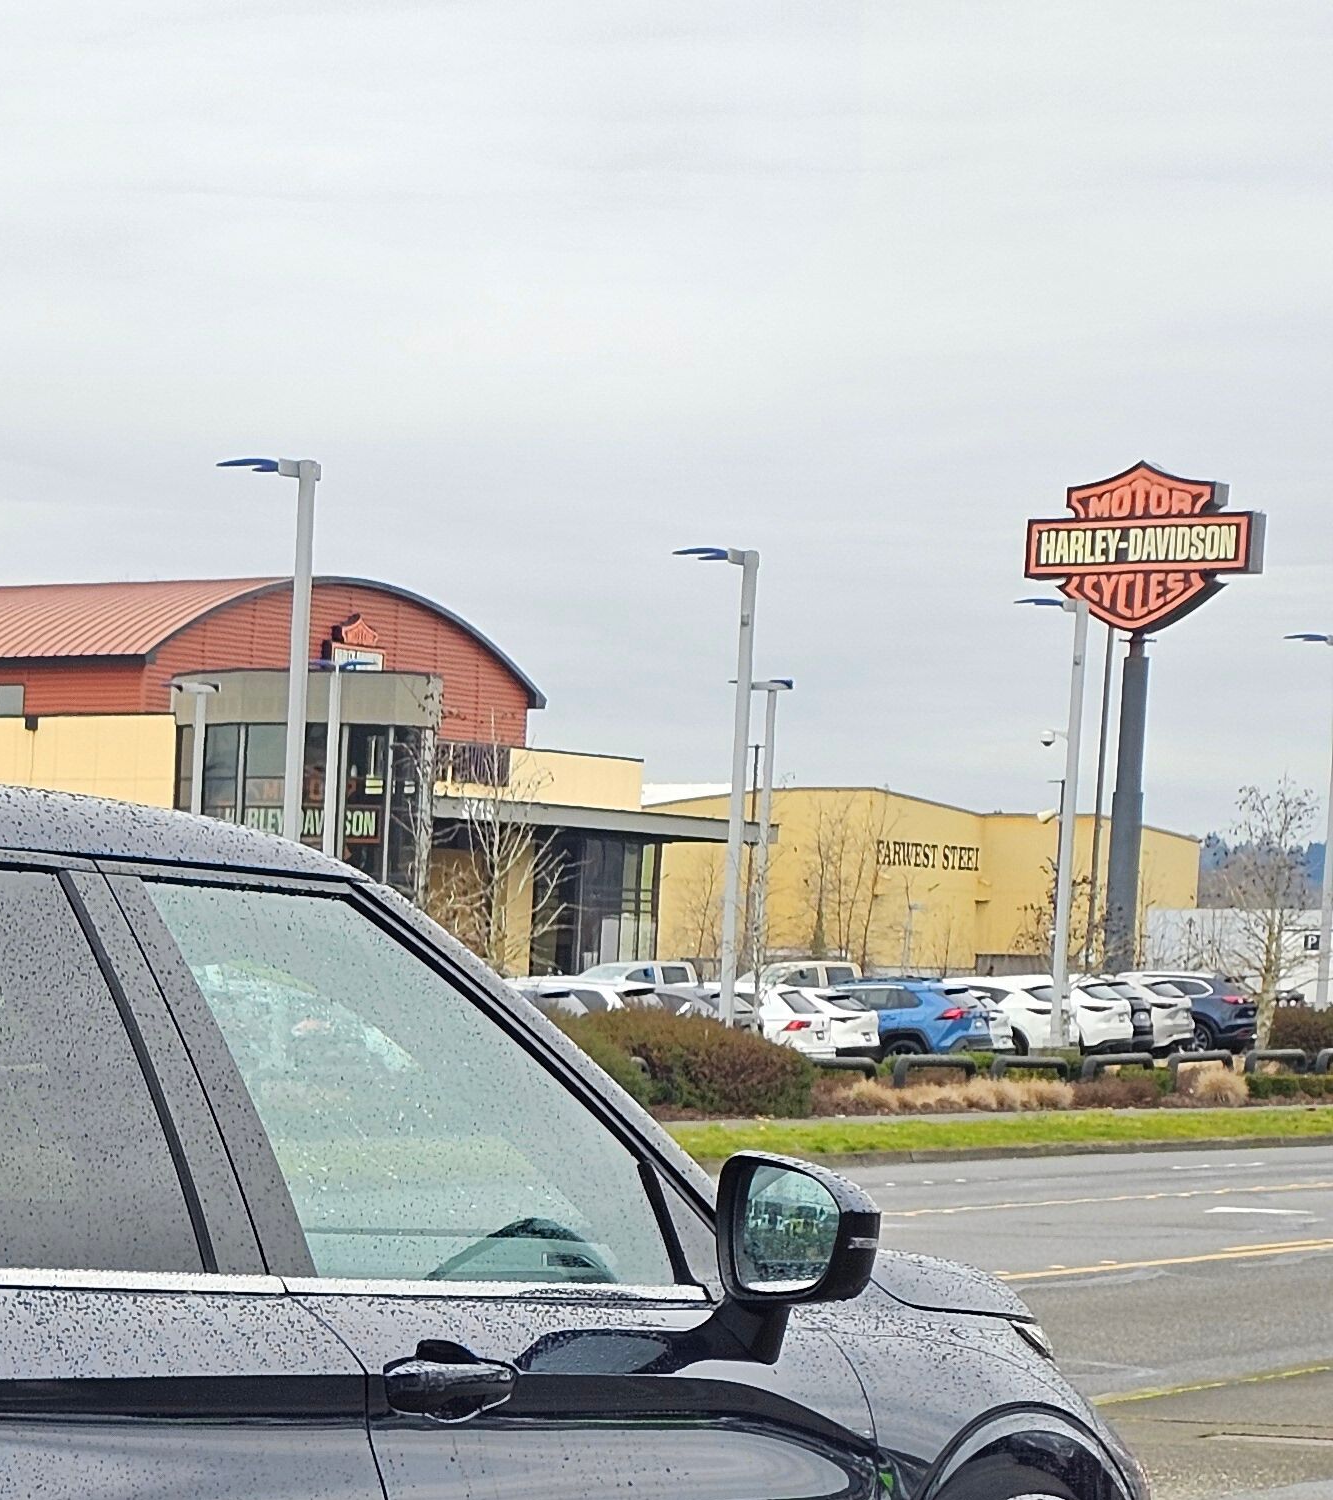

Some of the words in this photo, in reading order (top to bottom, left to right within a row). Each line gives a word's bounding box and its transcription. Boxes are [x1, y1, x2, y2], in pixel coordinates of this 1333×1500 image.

[1088, 479, 1194, 518] MOTOR
[1039, 524, 1237, 565] HARLEY-DAVIDSON
[1084, 573, 1188, 617] CYCLES
[876, 839, 938, 869] FARWEST
[1307, 935, 1318, 949] P
